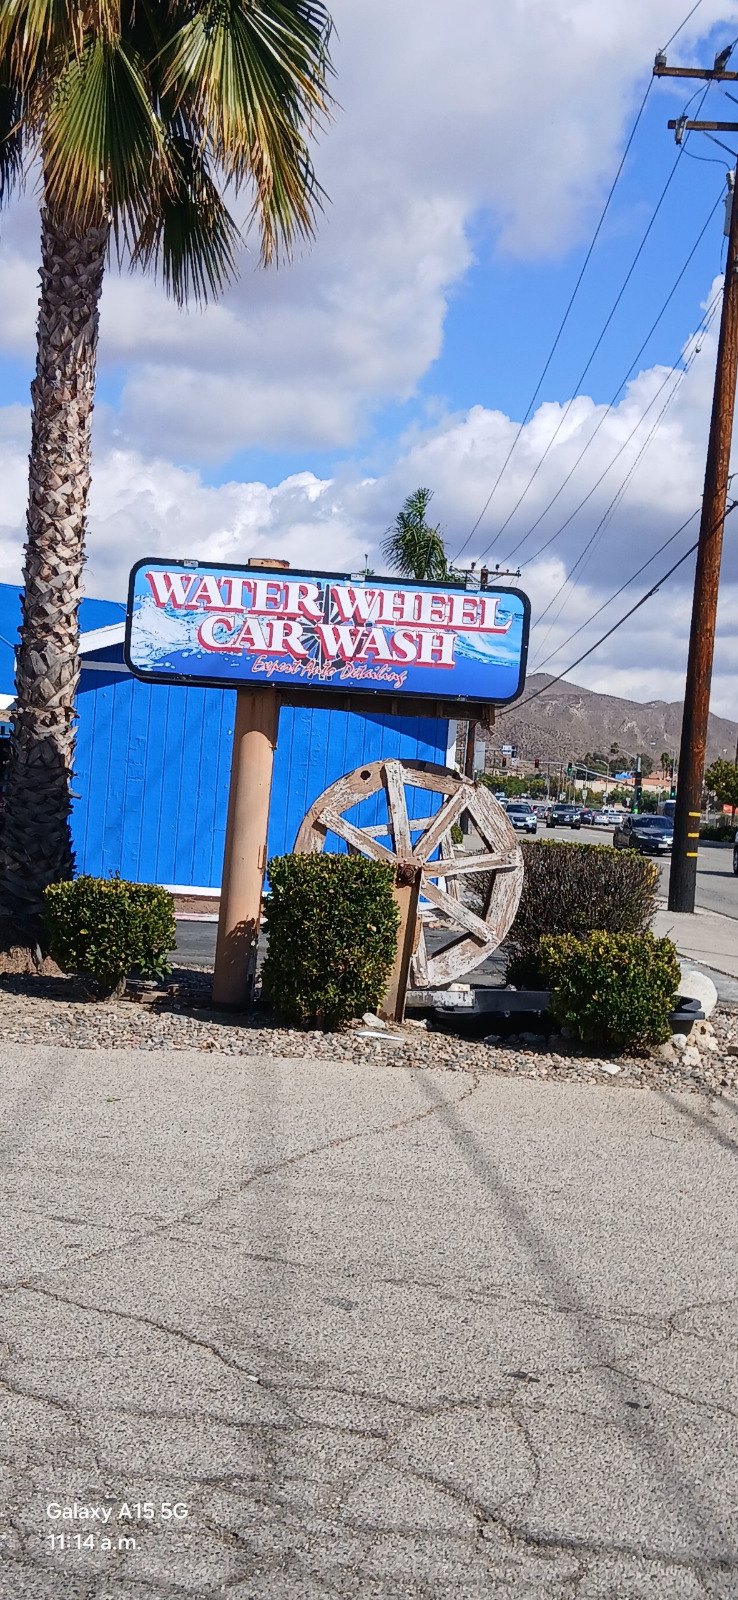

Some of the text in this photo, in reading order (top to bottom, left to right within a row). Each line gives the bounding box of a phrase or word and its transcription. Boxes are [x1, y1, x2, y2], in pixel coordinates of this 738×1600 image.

[145, 570, 513, 634] WATER WHEEL
[198, 614, 458, 669] CAR WASH
[252, 655, 408, 689] Expert Auto Detailing
